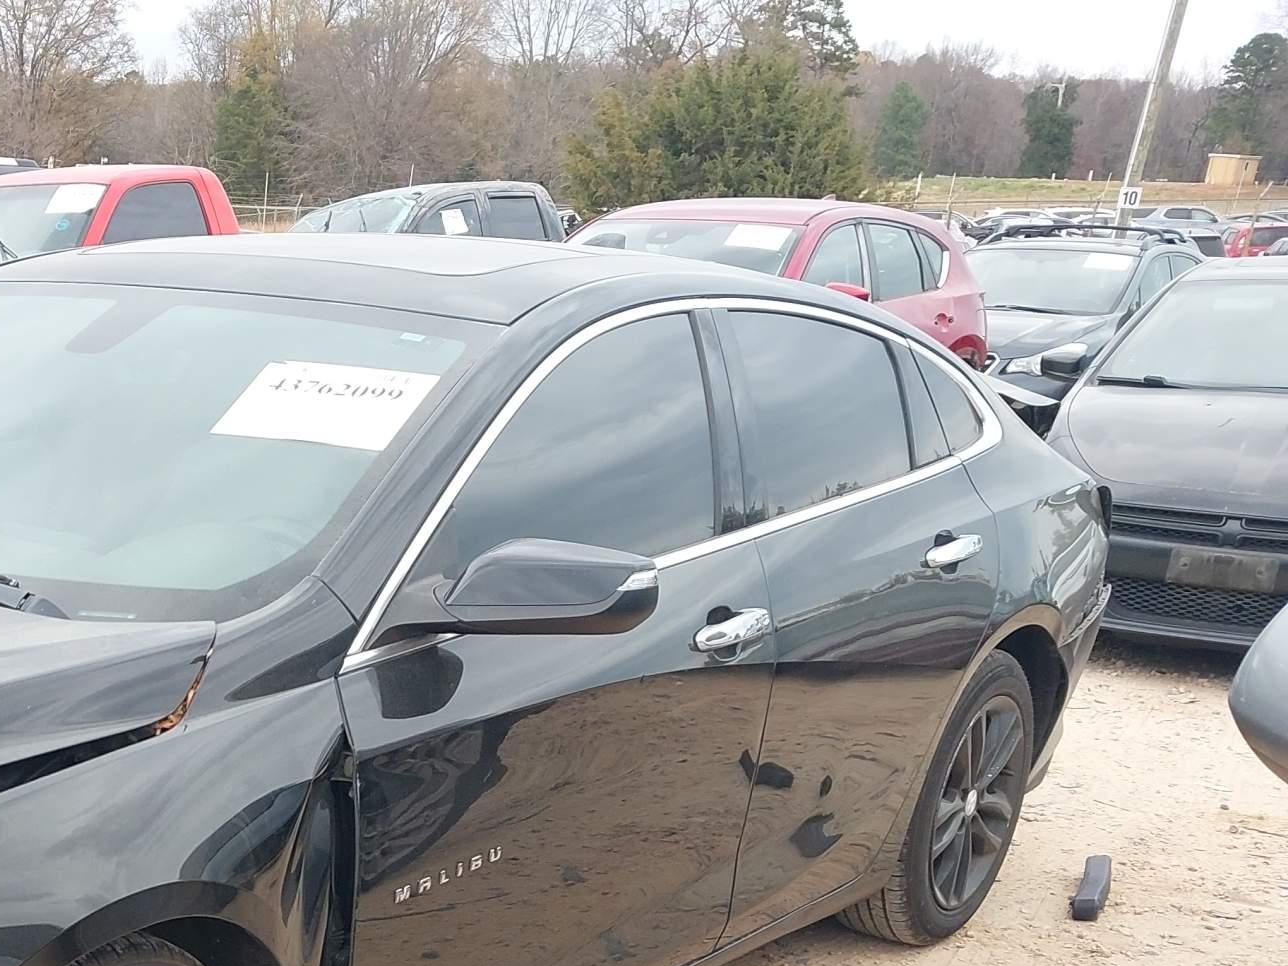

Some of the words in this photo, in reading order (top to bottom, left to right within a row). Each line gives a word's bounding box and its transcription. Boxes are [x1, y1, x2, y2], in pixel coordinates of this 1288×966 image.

[1123, 191, 1138, 206] 10
[269, 378, 405, 400] 43762099
[394, 846, 502, 904] MALIBU
